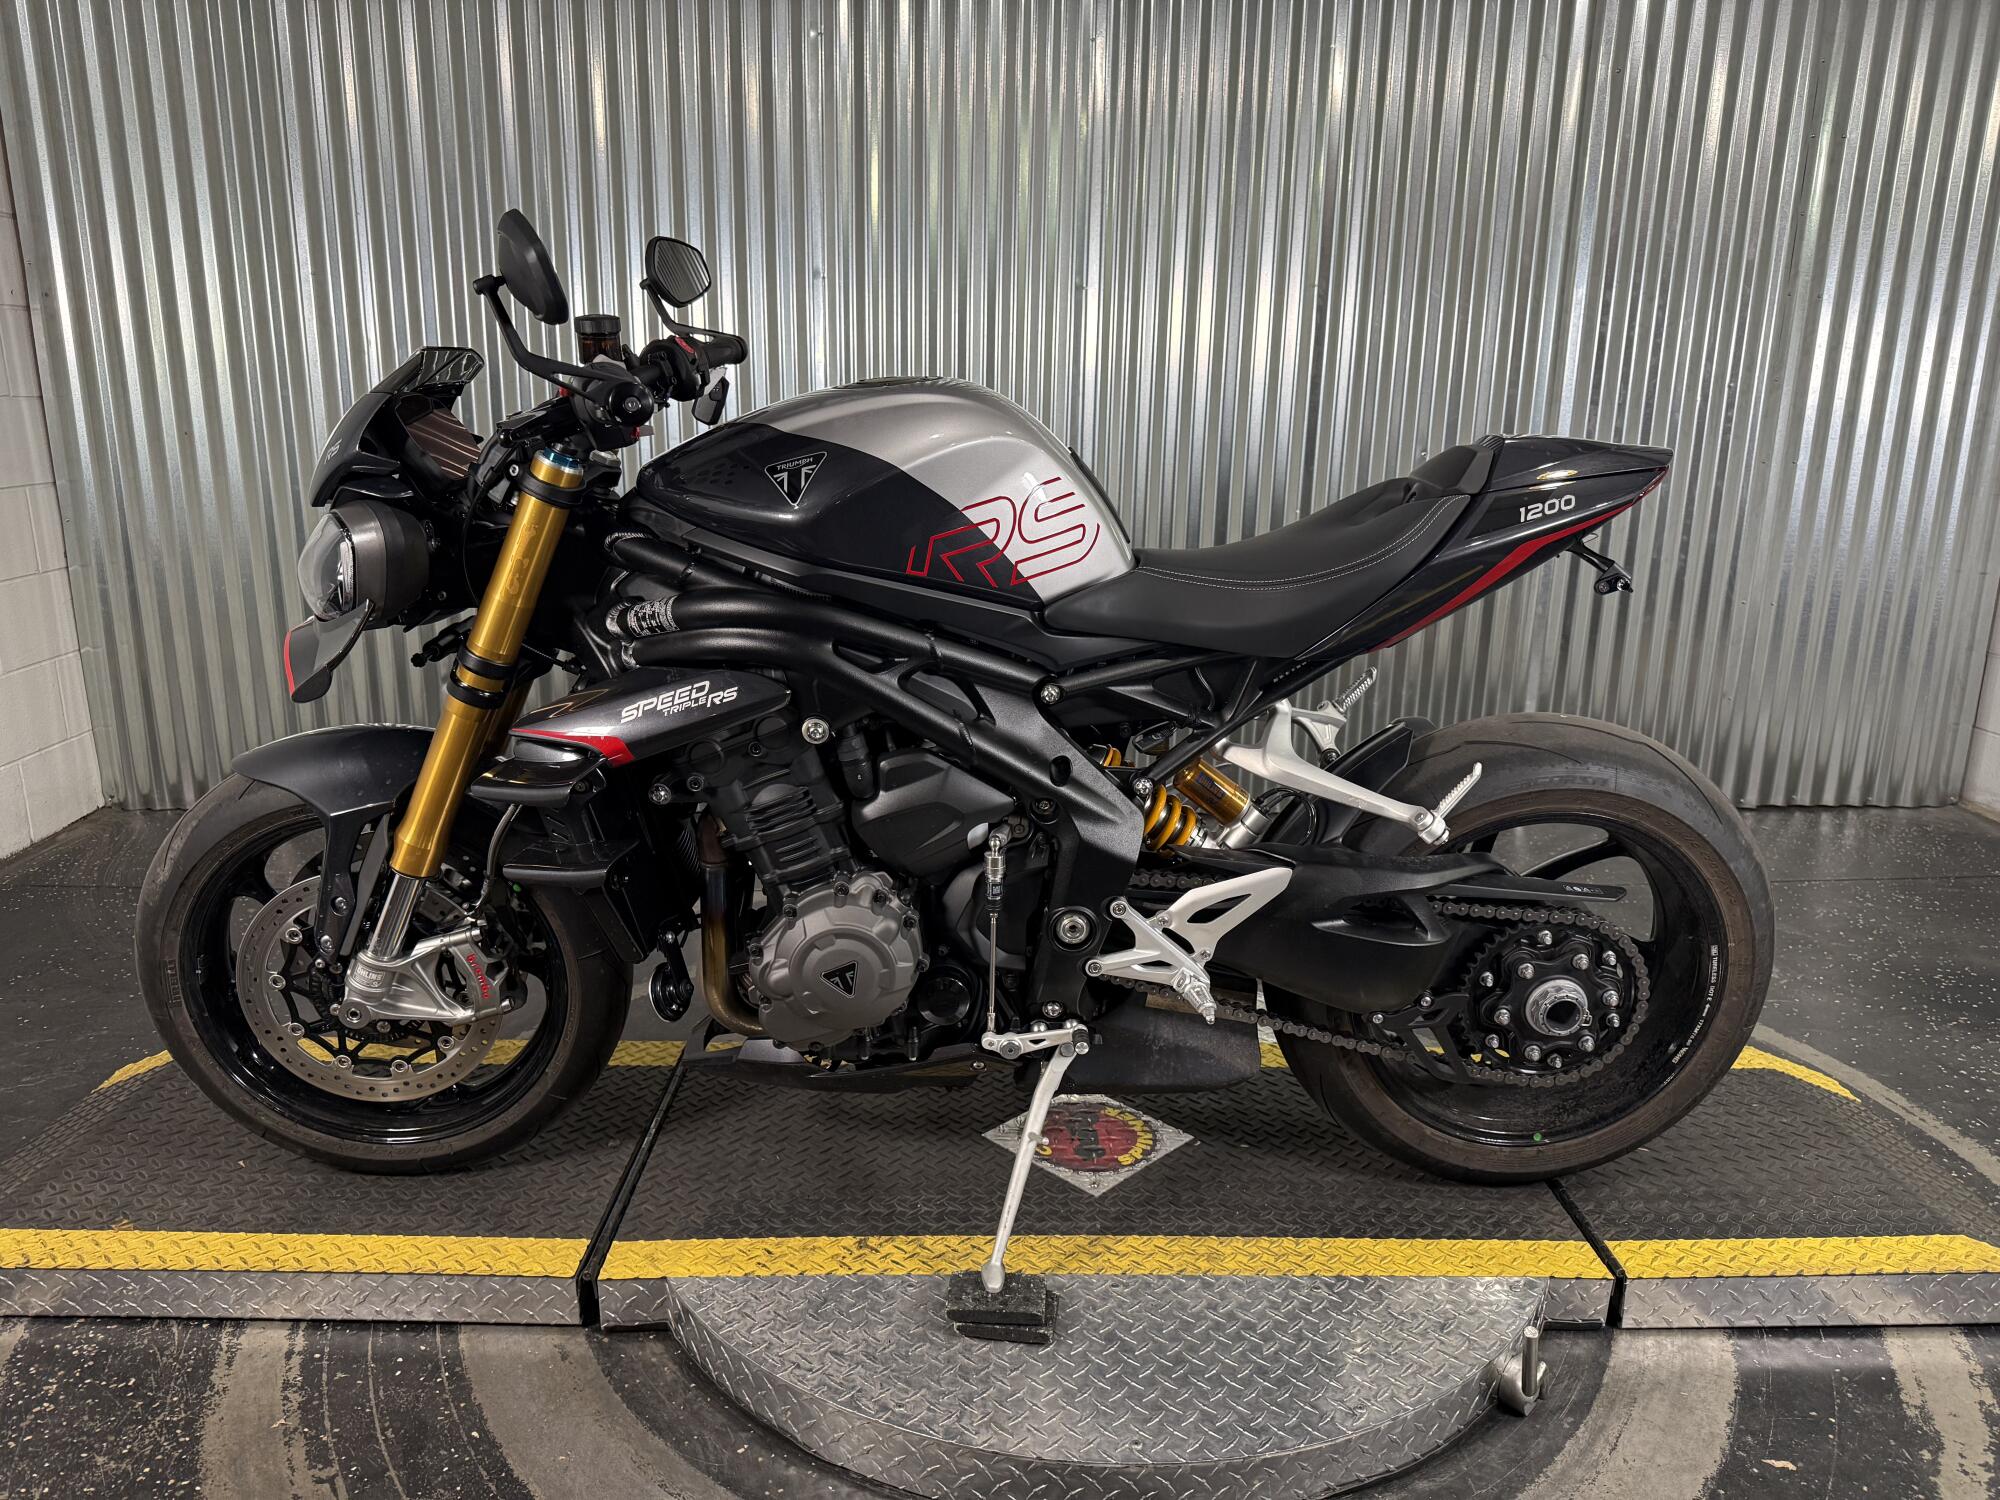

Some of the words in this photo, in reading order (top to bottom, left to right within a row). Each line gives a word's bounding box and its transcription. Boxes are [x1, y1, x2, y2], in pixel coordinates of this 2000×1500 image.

[776, 457, 814, 471] TRIUMPH
[1519, 494, 1577, 523] 1200
[905, 476, 1101, 589] RS
[620, 680, 710, 724] SPEED
[662, 697, 707, 717] TRIPLE
[706, 686, 739, 708] RS
[465, 953, 490, 999] brembo
[1103, 1106, 1153, 1166] SPINNER
